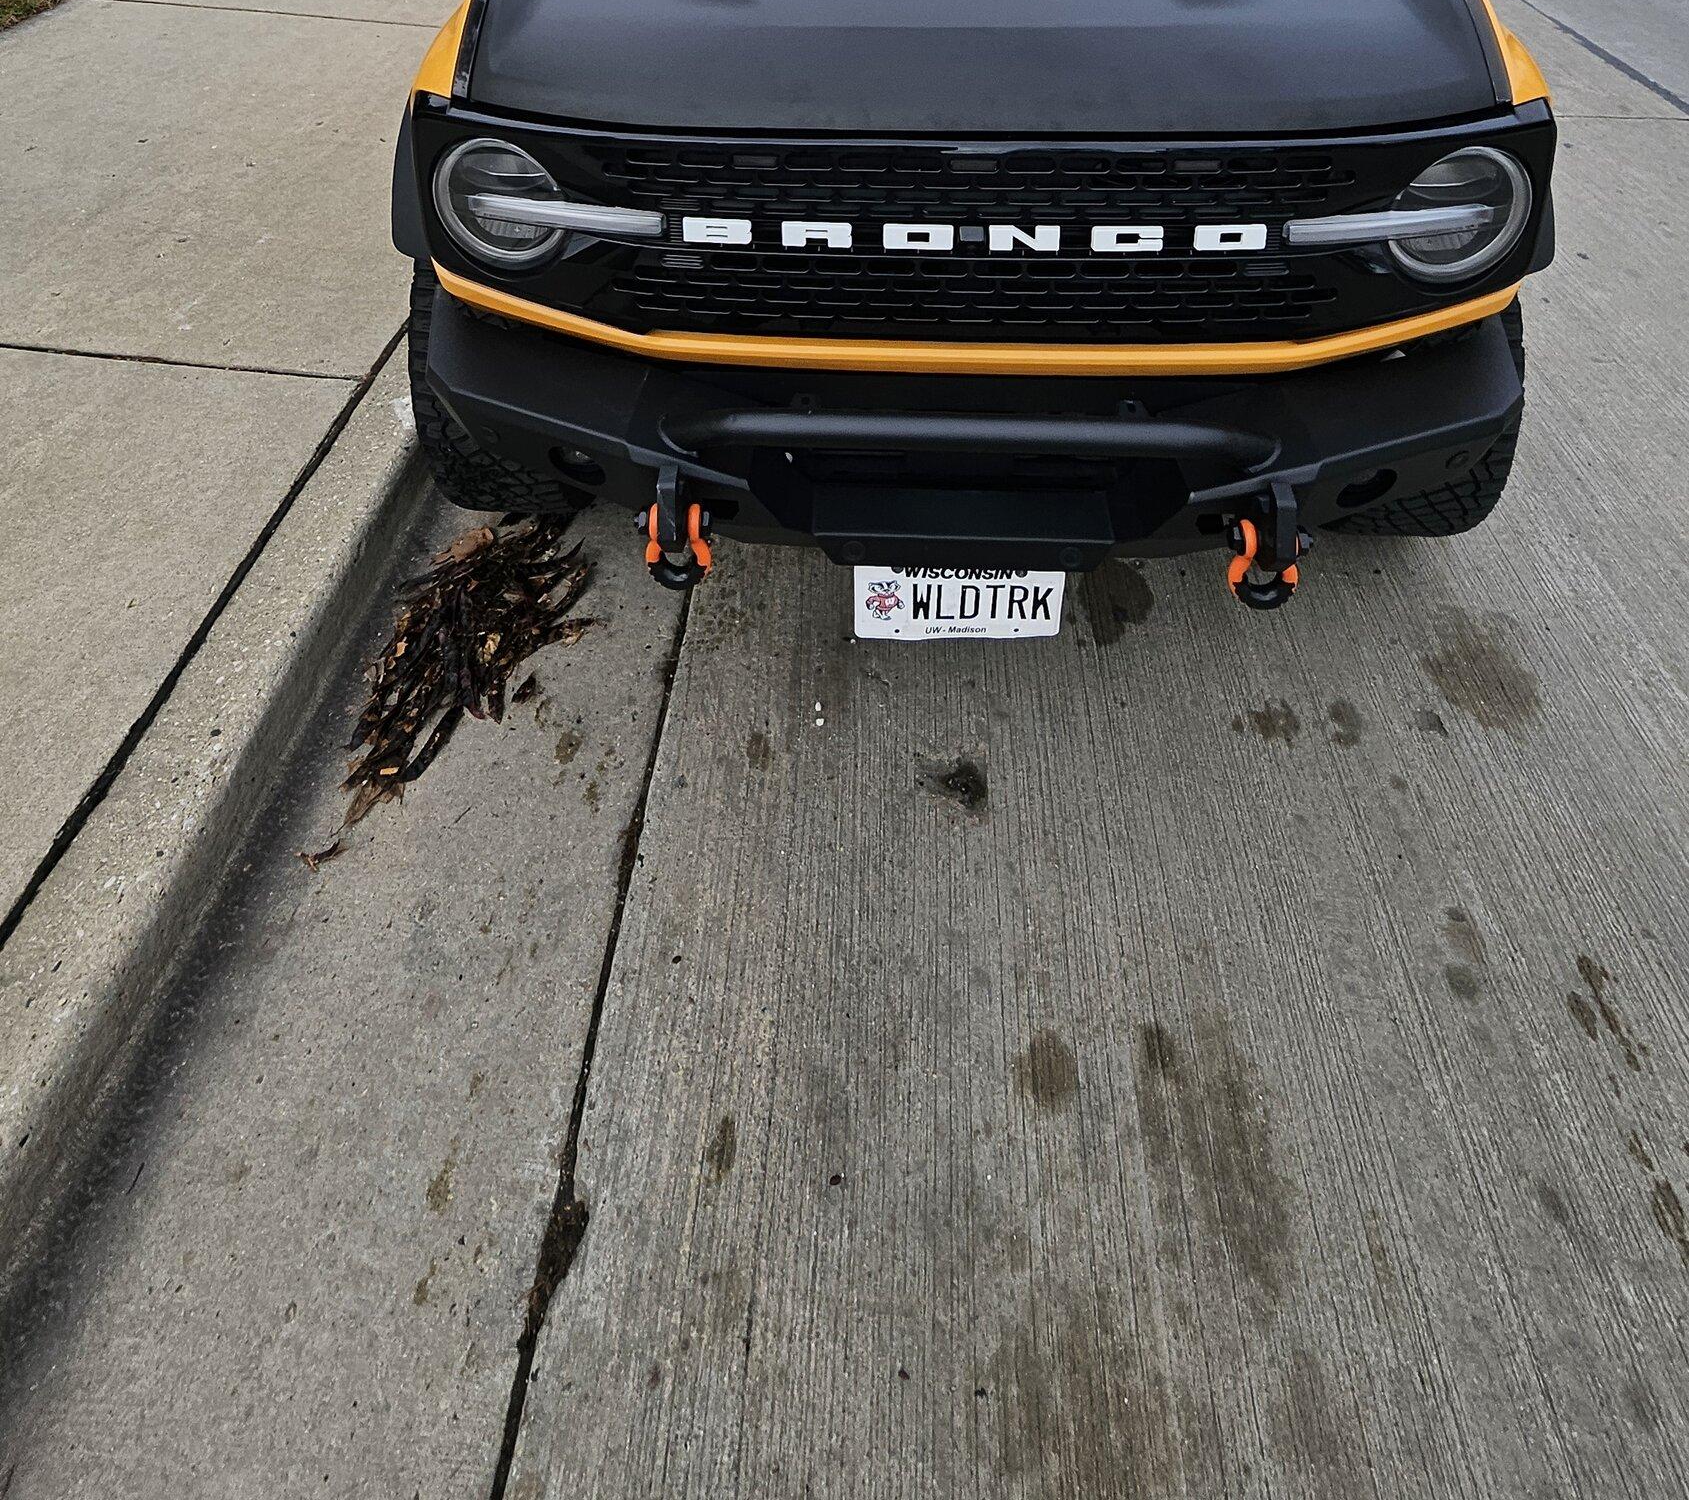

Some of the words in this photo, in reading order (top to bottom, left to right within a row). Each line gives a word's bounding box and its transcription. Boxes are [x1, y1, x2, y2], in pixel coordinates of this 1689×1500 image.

[683, 217, 1268, 252] BRONCO
[904, 567, 1013, 580] WISCONSIN
[912, 583, 1054, 620] WLDTRK
[948, 626, 987, 634] Madison
